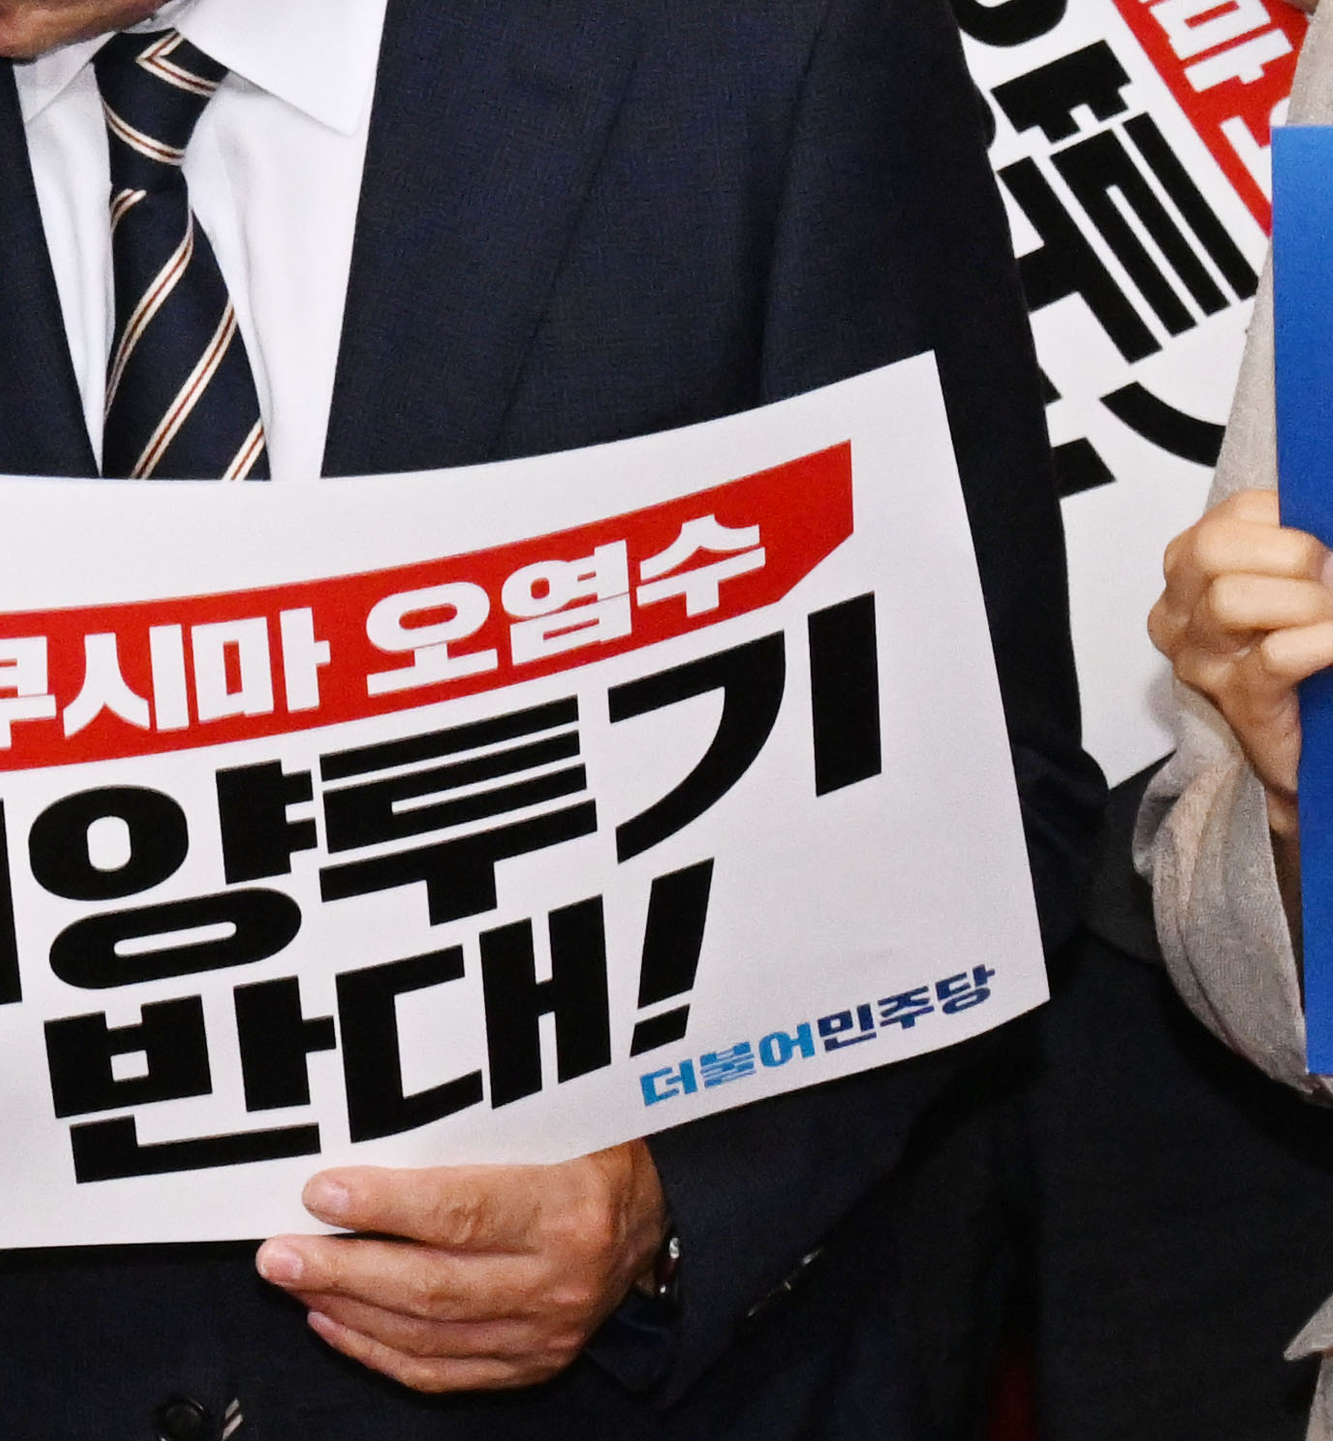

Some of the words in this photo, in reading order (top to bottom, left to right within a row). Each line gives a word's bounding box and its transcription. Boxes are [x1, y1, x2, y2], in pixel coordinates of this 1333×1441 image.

[365, 514, 766, 700] 오염수
[43, 857, 716, 1185] 반대!
[639, 963, 996, 1107] 더불어민주당
